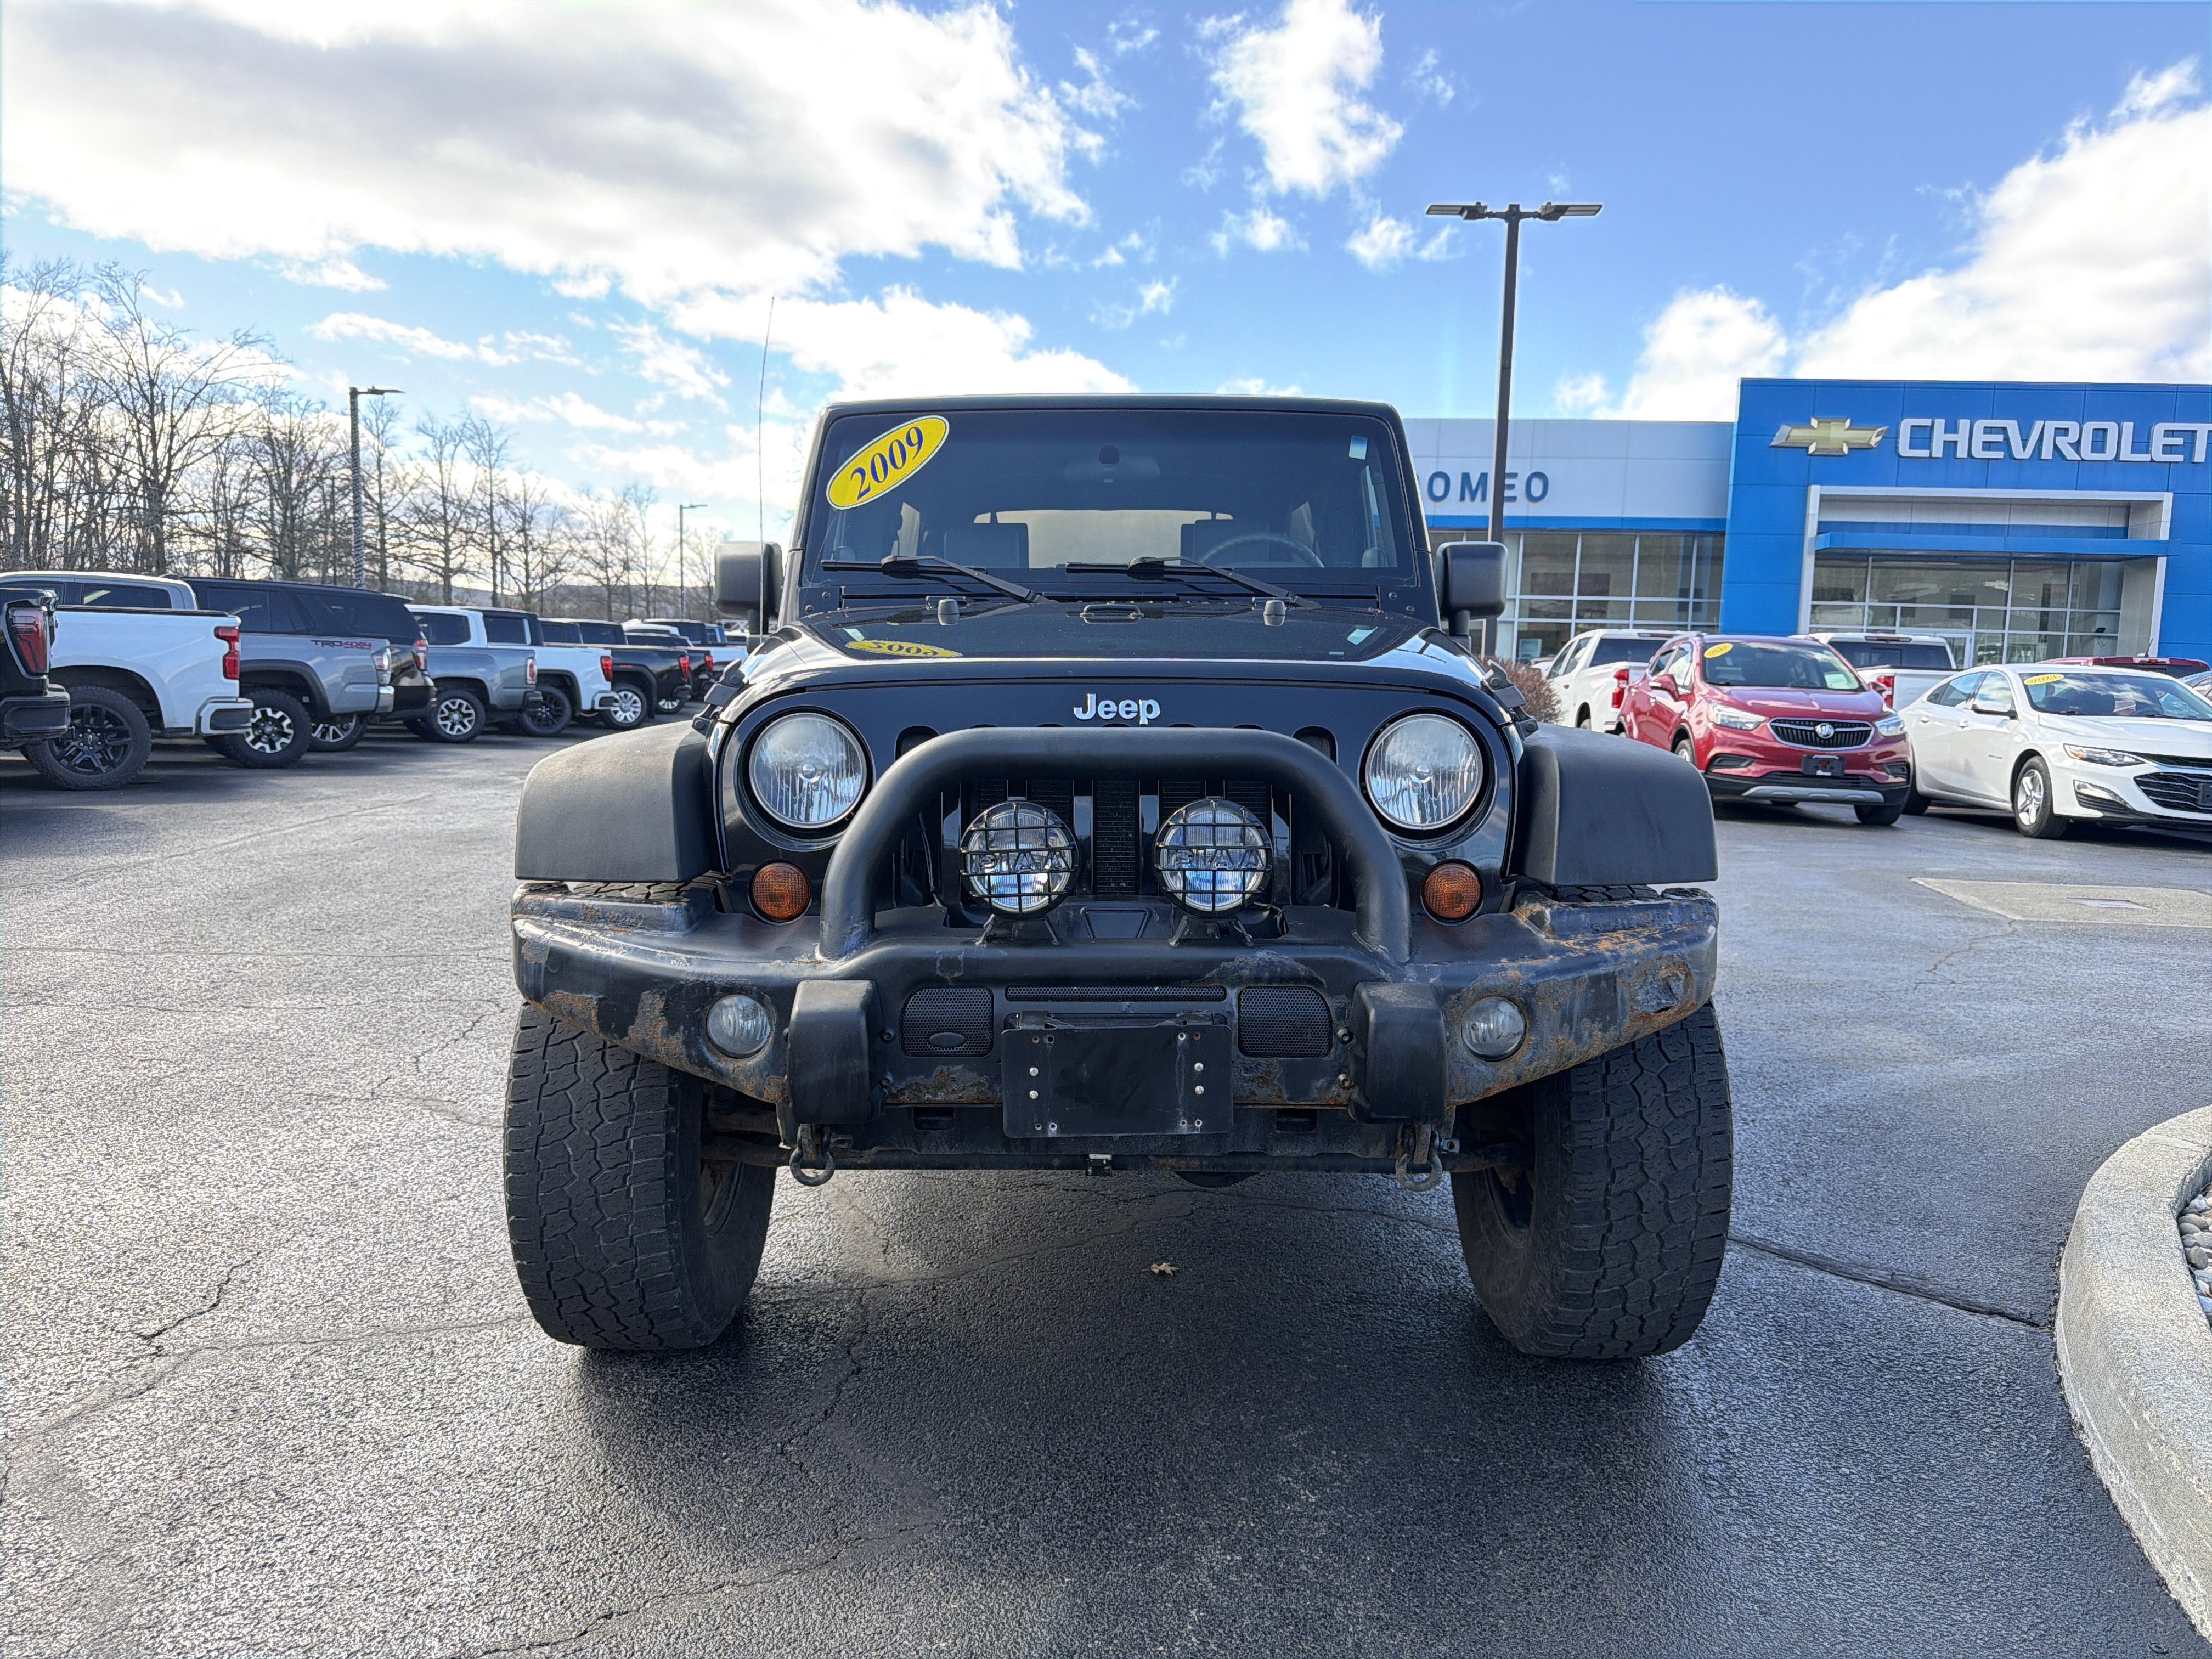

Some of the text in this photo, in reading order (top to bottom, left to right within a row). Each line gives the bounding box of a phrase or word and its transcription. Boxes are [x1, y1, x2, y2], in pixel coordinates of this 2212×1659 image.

[1898, 417, 2212, 462] CHEVROLET
[850, 426, 923, 500] 2009
[1417, 471, 1549, 503] OMEO
[1073, 693, 1160, 725] Jeep
